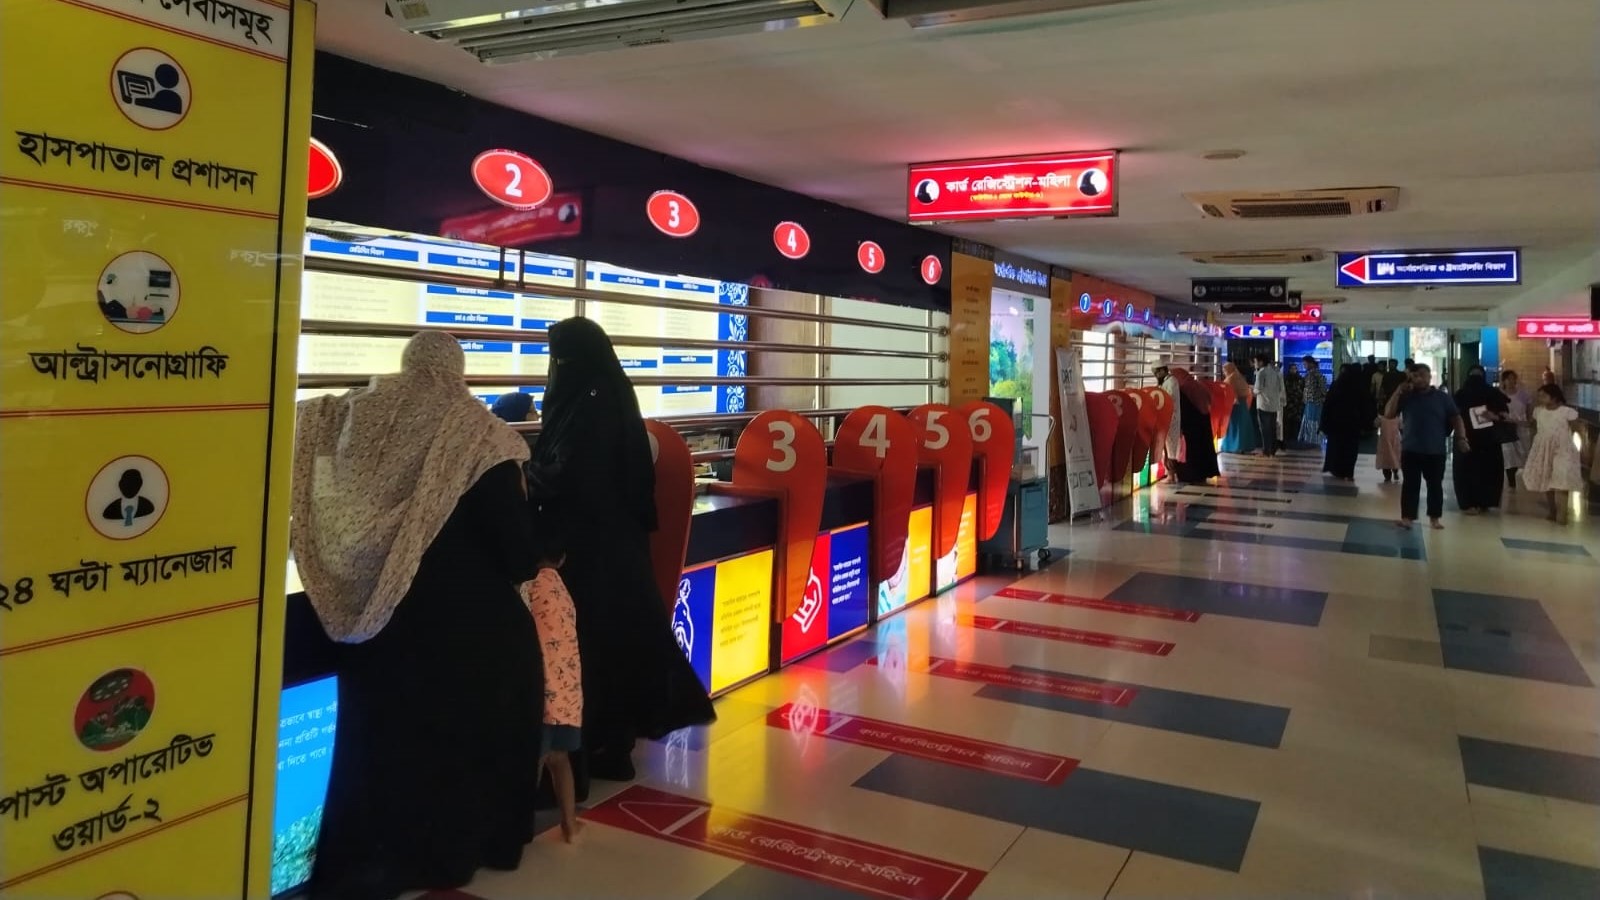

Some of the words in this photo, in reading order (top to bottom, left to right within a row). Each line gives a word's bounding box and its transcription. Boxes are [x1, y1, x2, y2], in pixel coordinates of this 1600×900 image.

[16, 131, 164, 181] হাসপাতাল
[172, 158, 258, 195] প্রশাসন
[505, 163, 523, 197] 2
[668, 200, 680, 229] 3
[787, 229, 797, 252] 4
[866, 247, 876, 267] 5
[927, 261, 936, 280] 6
[28, 343, 229, 384] আল্ট্রাসনোগ্রাফি
[859, 414, 890, 458] 4
[925, 410, 949, 449] 5
[968, 408, 992, 442] 6
[766, 420, 796, 471] 3
[120, 545, 237, 586] ম্যানেজার
[0, 773, 70, 820] পাস্ট
[78, 732, 215, 793] অপারেটিভ
[52, 795, 162, 851] ওয়ার্ড-২
